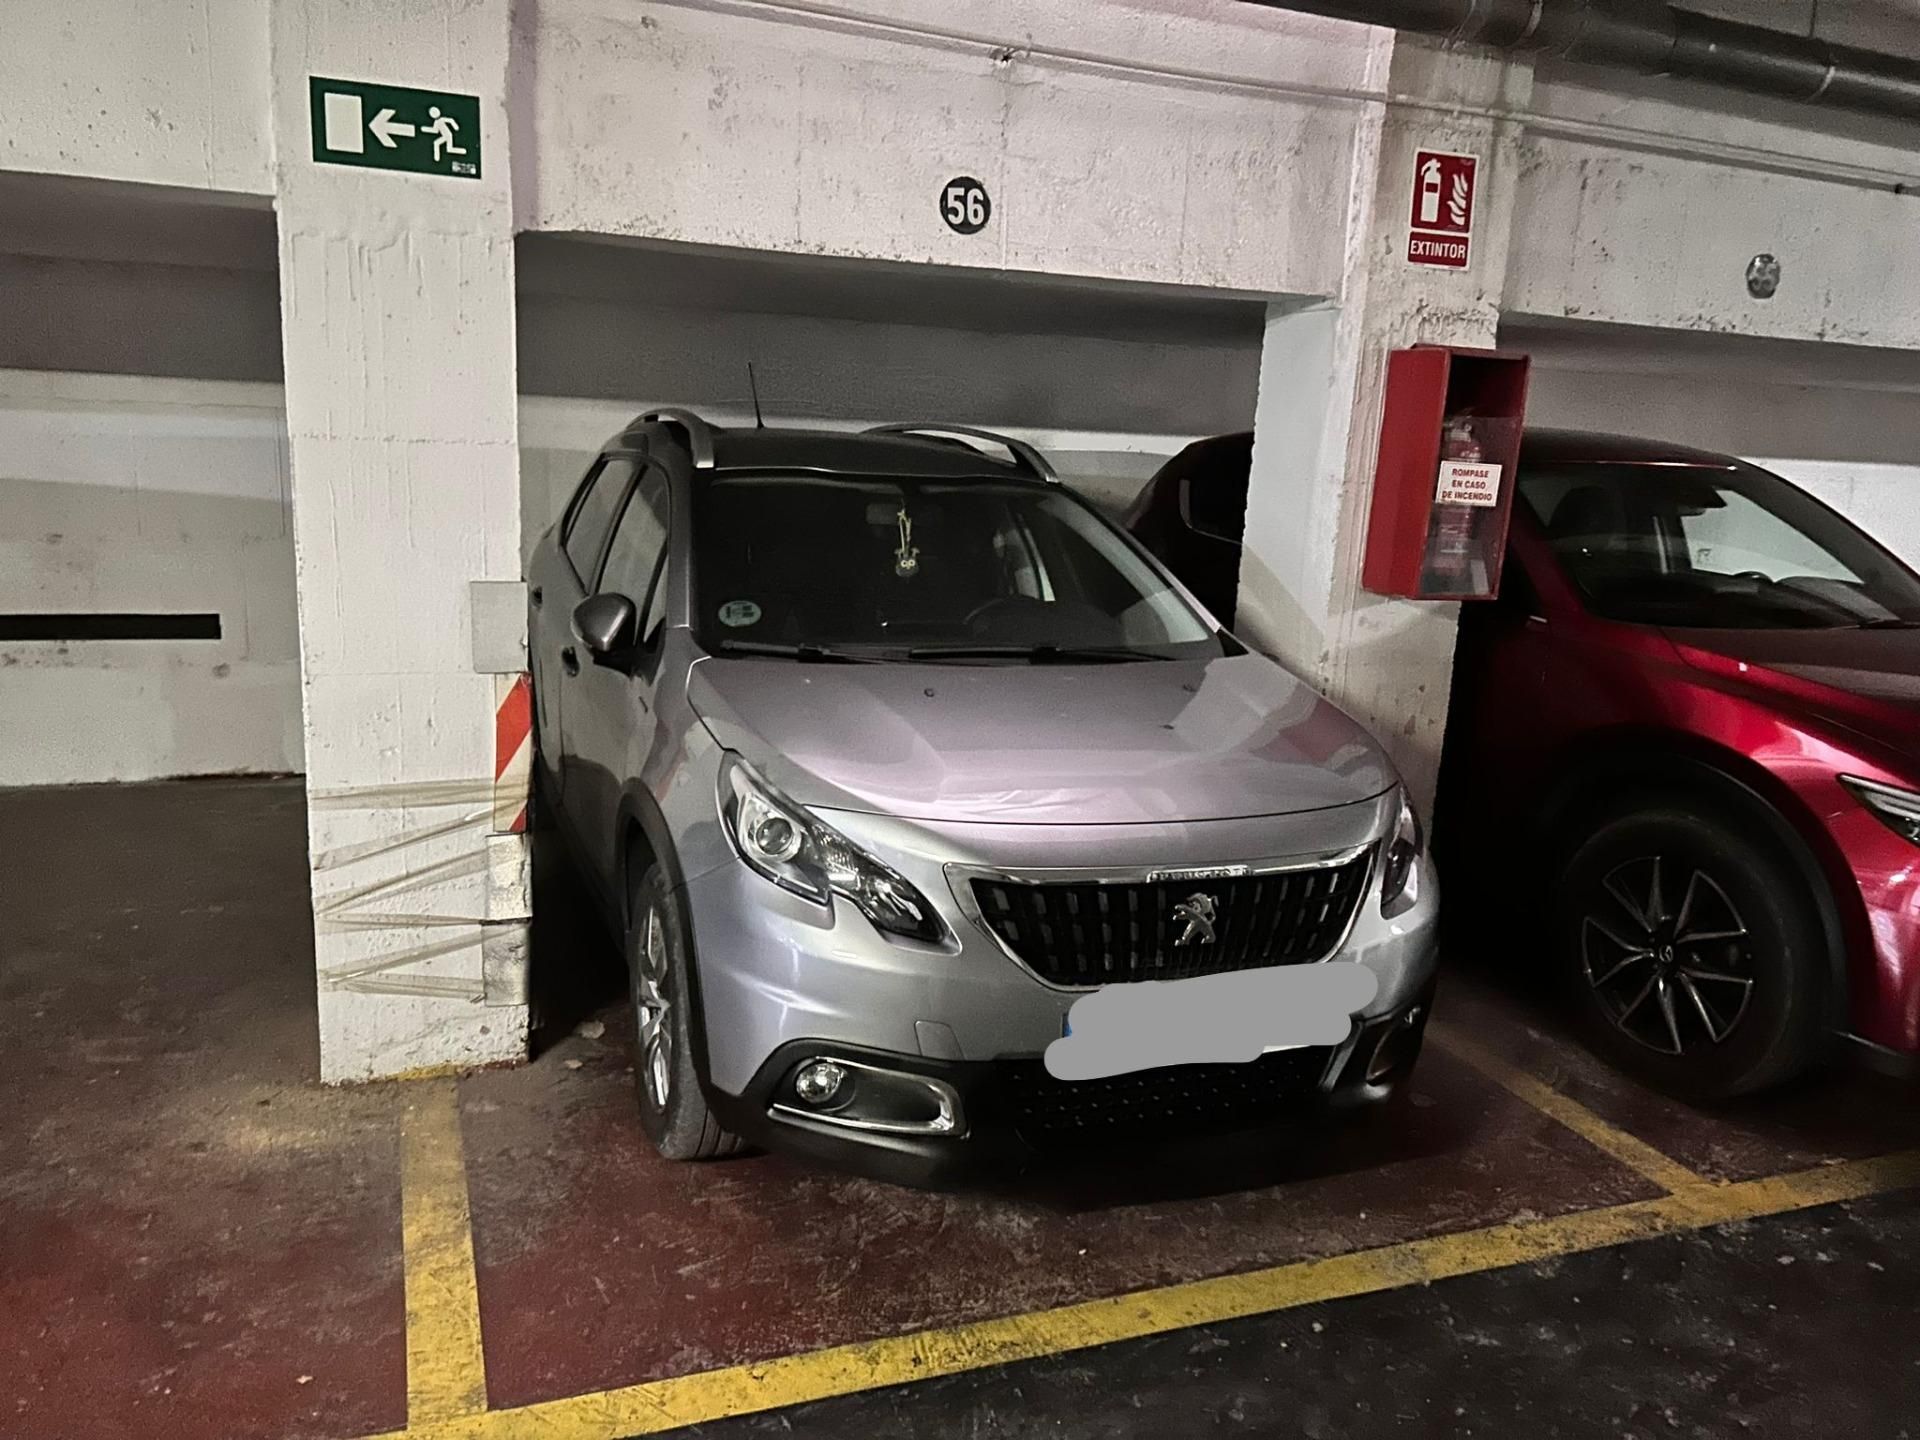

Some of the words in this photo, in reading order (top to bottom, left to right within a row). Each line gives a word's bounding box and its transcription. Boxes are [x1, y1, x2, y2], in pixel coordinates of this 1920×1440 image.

[947, 187, 984, 225] 56
[1410, 240, 1467, 259] EXTINTOR
[1452, 468, 1489, 478] ROMPASE
[1452, 480, 1463, 488] EN
[1464, 480, 1486, 489] CASO
[1442, 491, 1453, 499] DE
[1454, 492, 1492, 501] INCENDIO
